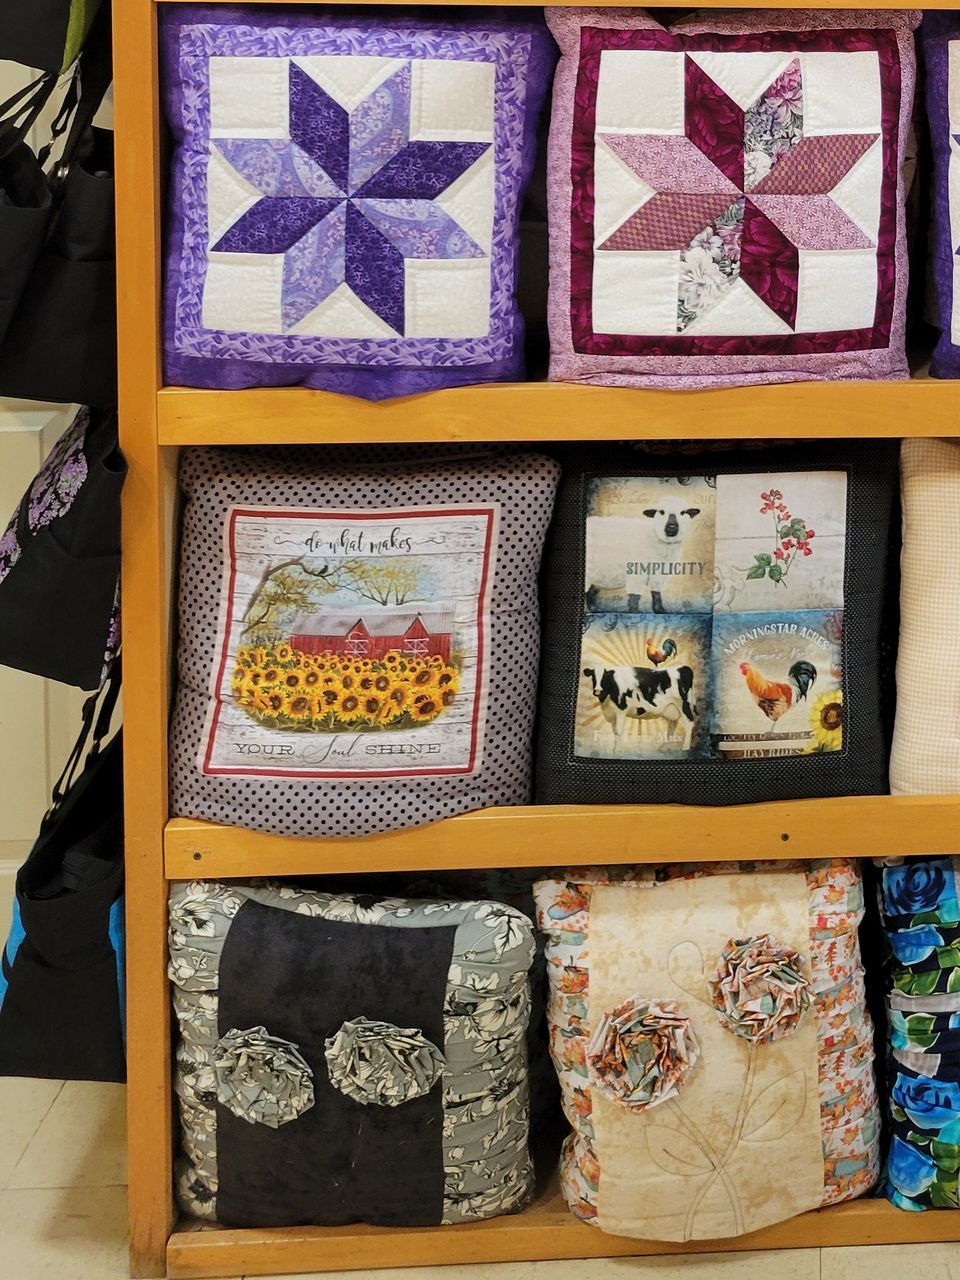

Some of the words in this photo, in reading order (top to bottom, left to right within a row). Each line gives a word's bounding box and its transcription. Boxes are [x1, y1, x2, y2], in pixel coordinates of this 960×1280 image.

[304, 530, 322, 552] do
[328, 528, 365, 554] what
[369, 527, 413, 554] makes
[626, 561, 705, 576] SIMPLICITY
[723, 622, 798, 657] MORNINGSTAR
[799, 626, 830, 650] ACRES
[234, 742, 296, 756] YOUR
[302, 734, 364, 764] Soul
[365, 743, 442, 755] SHINE
[743, 749, 767, 758] HAY
[768, 748, 801, 757] RIDES
